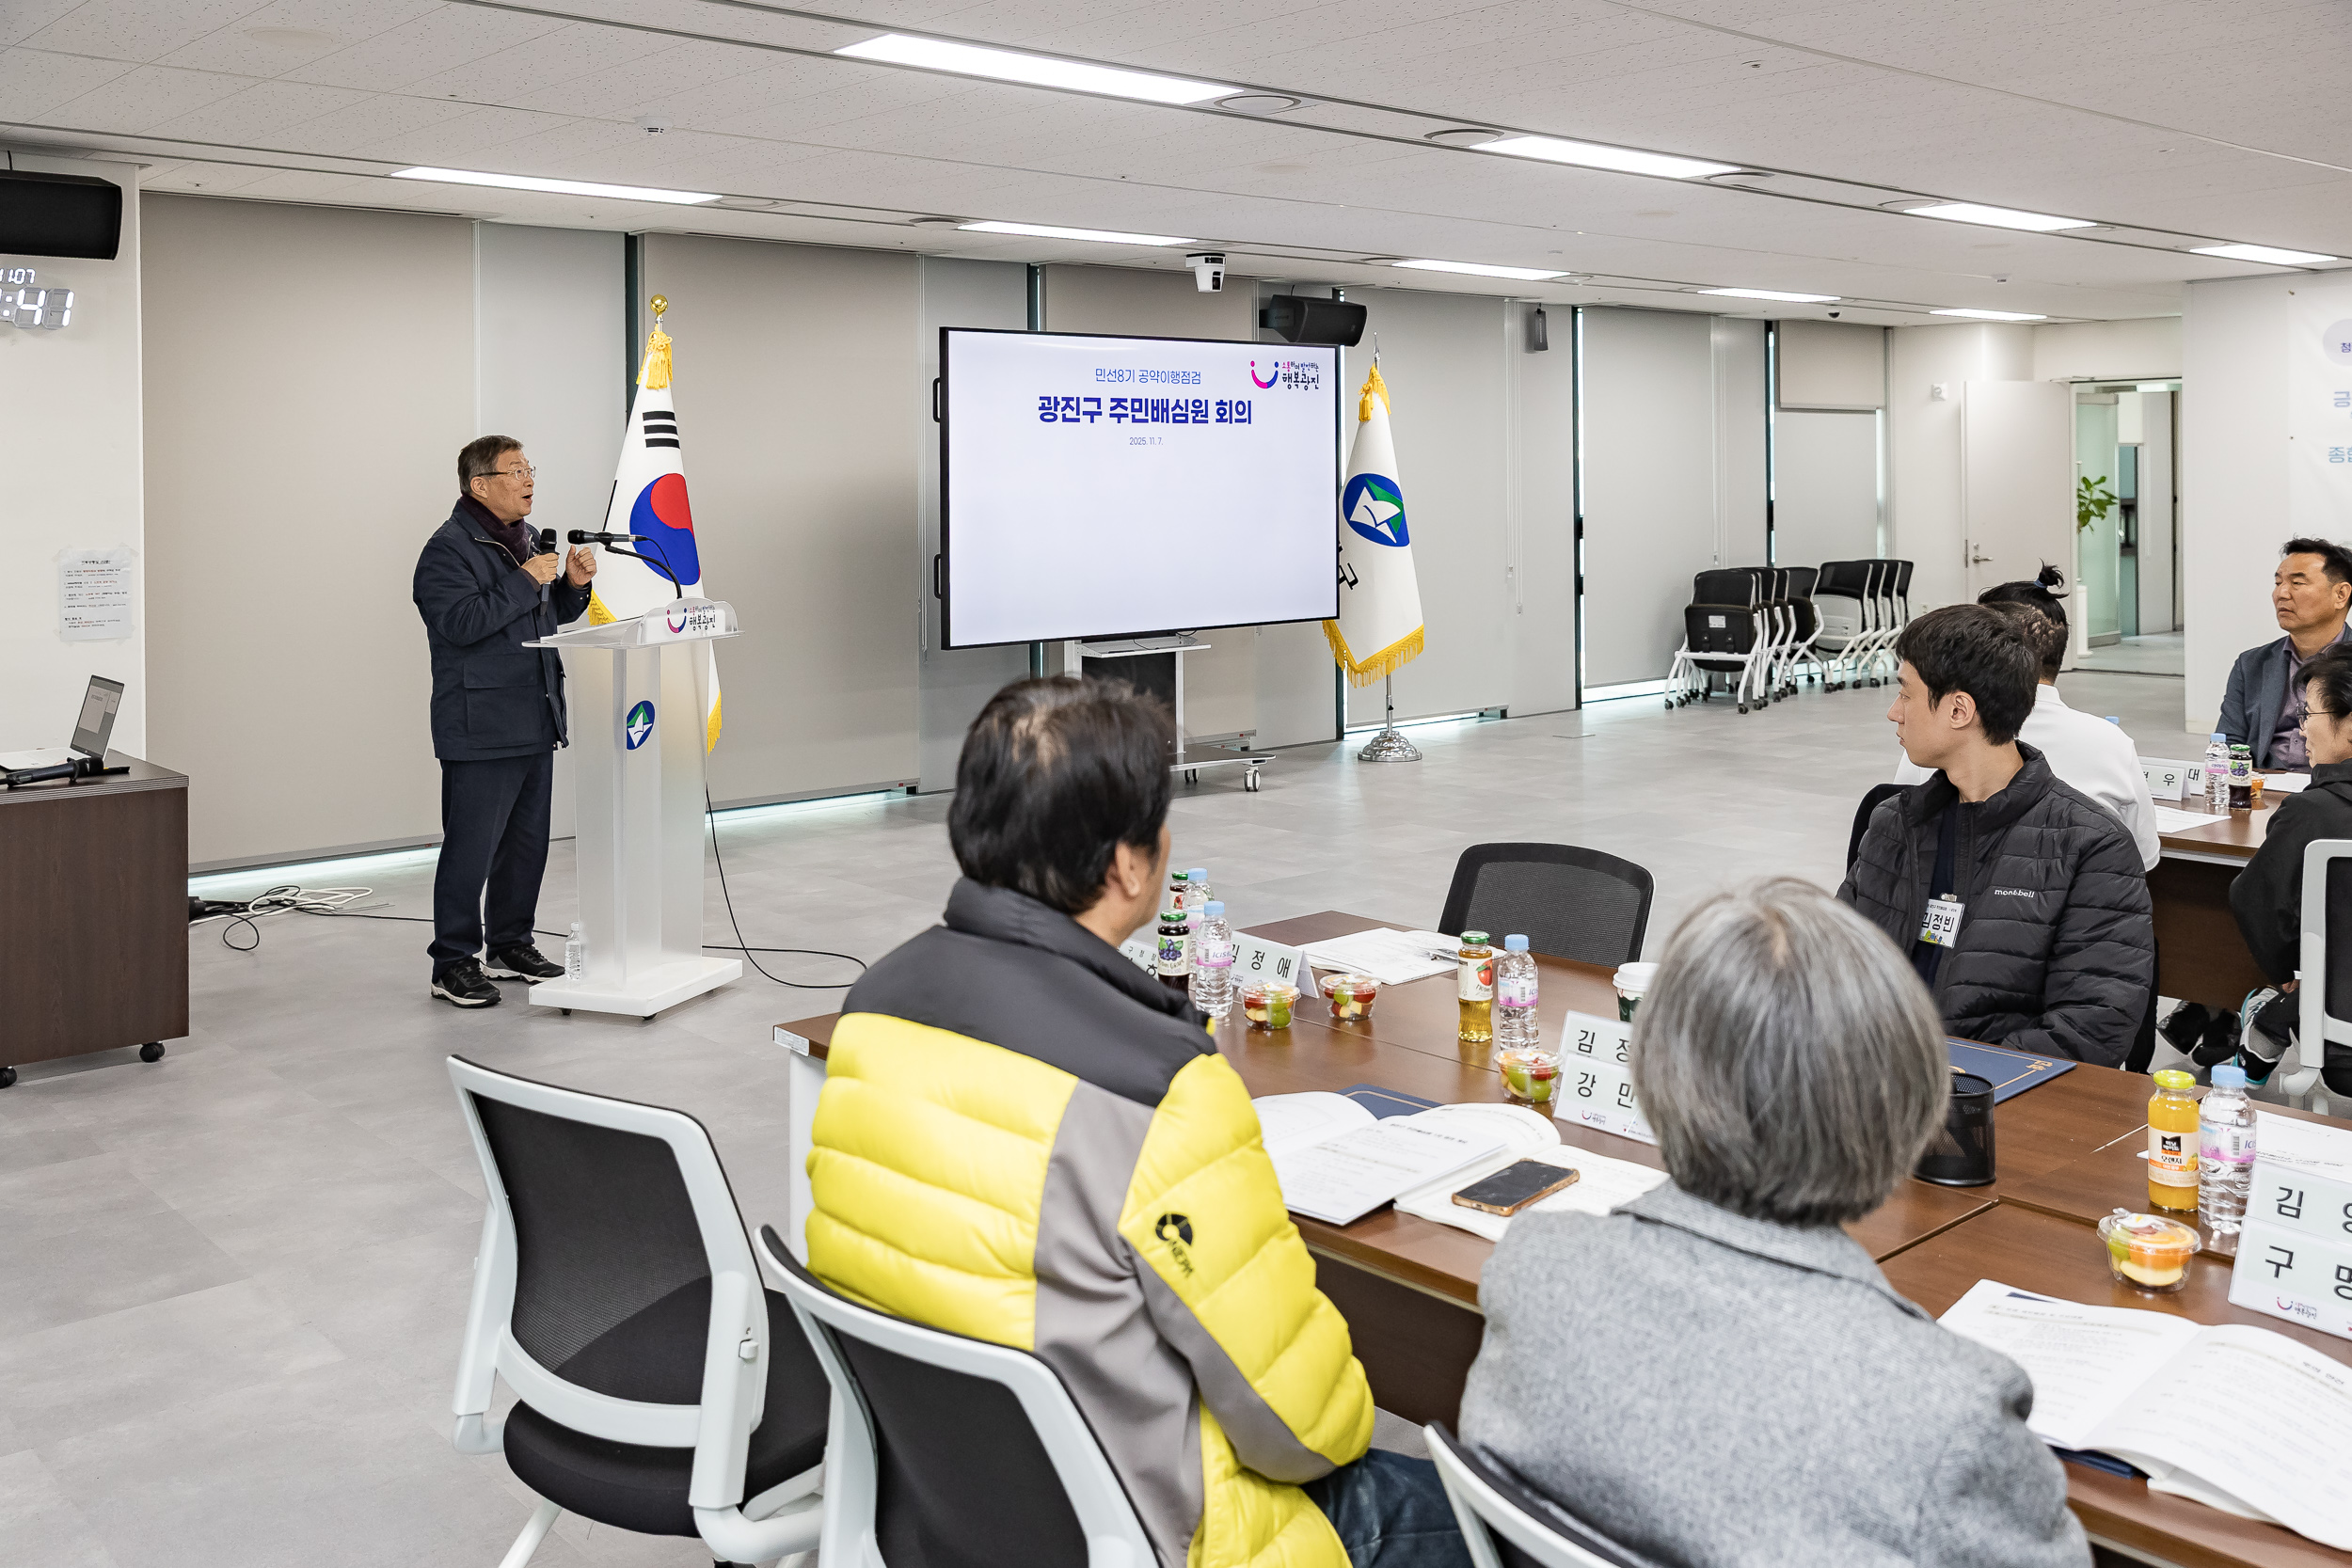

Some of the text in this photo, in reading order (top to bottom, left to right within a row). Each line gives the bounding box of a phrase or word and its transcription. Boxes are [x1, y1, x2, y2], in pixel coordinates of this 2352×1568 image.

[0, 288, 75, 327] :41
[1095, 368, 1201, 385] 민선8기 공약이행점검
[1281, 372, 1319, 391] 행복광진
[1038, 396, 1252, 425] 광진구 주민배심원 회의
[1922, 912, 1955, 933] 김정빈
